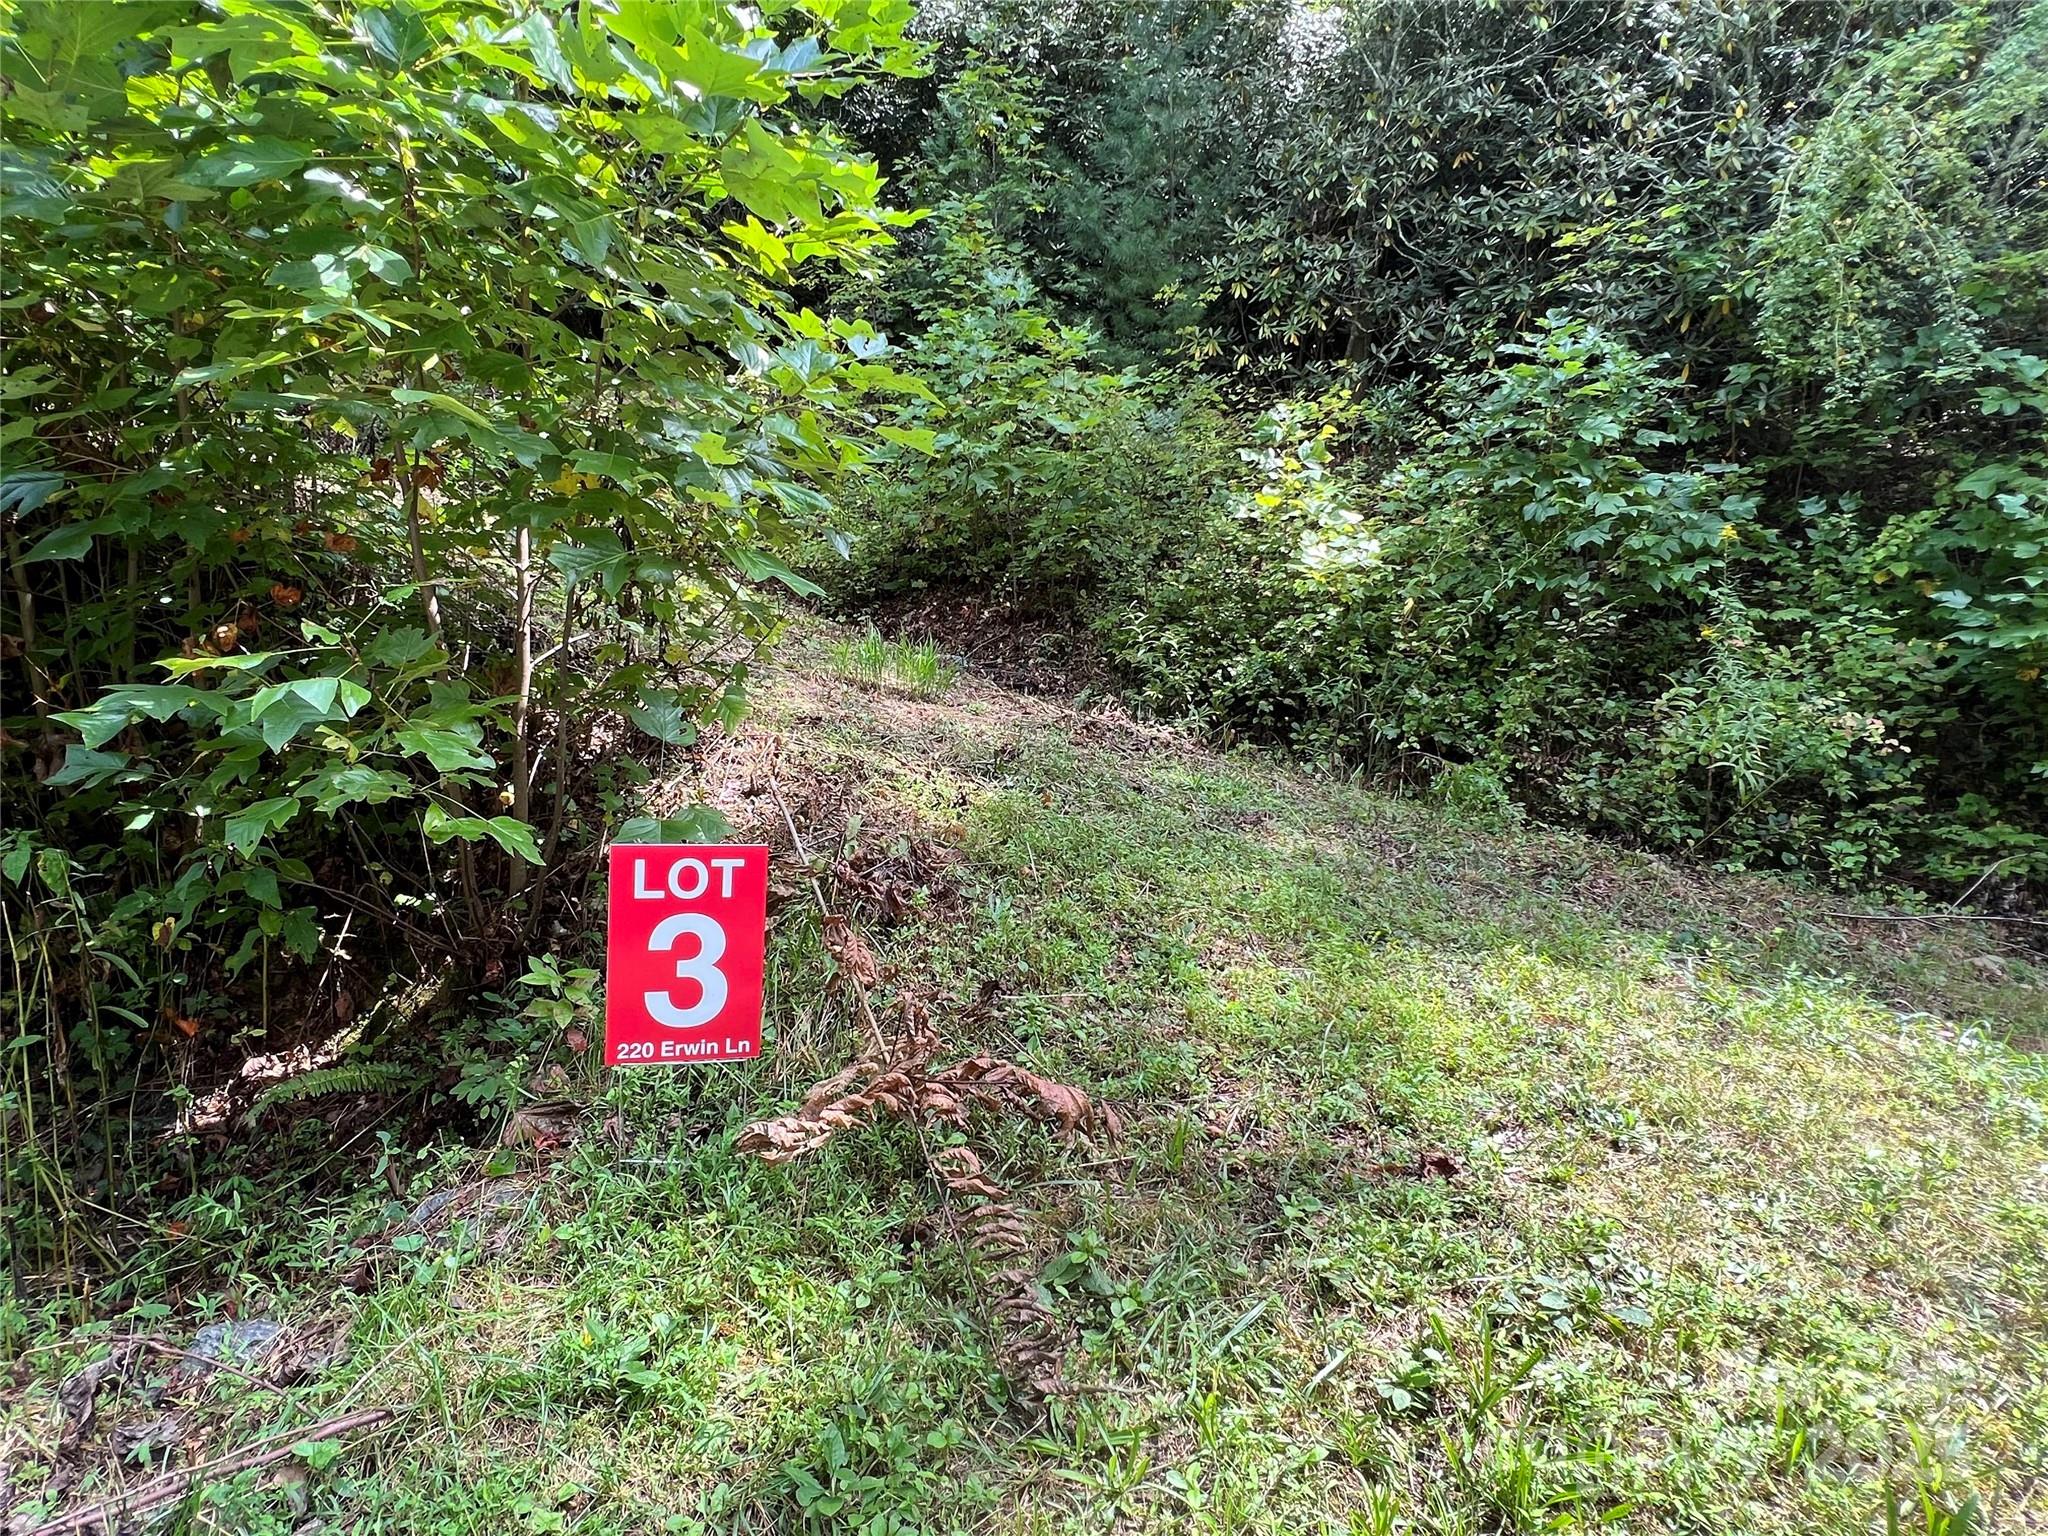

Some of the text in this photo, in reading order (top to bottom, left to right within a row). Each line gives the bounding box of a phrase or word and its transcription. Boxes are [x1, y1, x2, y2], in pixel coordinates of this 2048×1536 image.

[634, 857, 745, 899] LOT
[644, 912, 728, 1028] 3
[617, 1038, 750, 1059] 220 Erwin Ln
